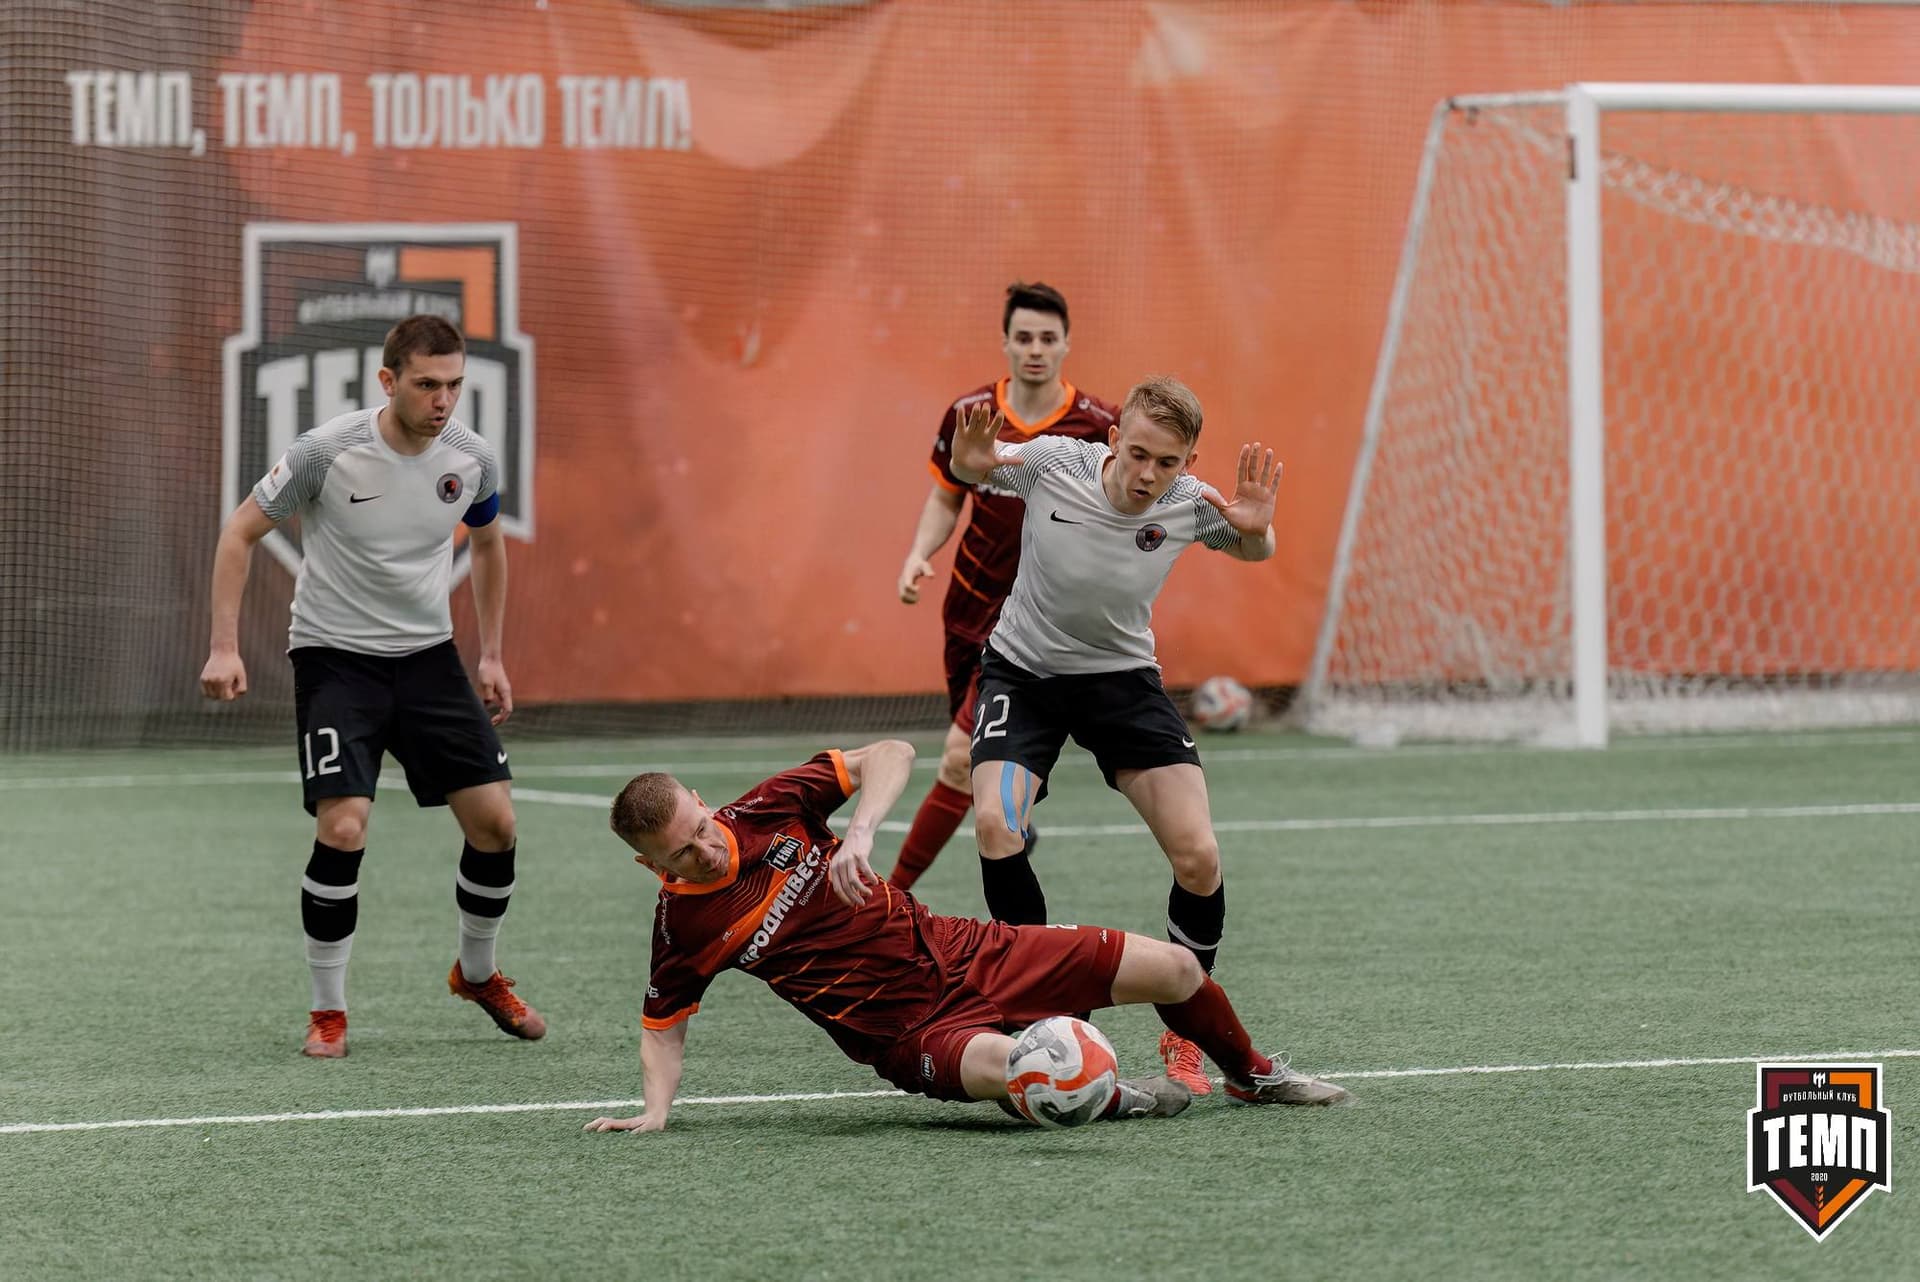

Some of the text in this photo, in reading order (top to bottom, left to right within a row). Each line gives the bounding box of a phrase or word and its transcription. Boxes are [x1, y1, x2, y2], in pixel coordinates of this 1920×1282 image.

[66, 70, 693, 156] ТЕМП, ТЕМП, ТОЛЬКО ТЕМП!
[256, 346, 508, 494] ТЕП
[303, 726, 342, 780] 12
[772, 839, 799, 868] ТЕМП
